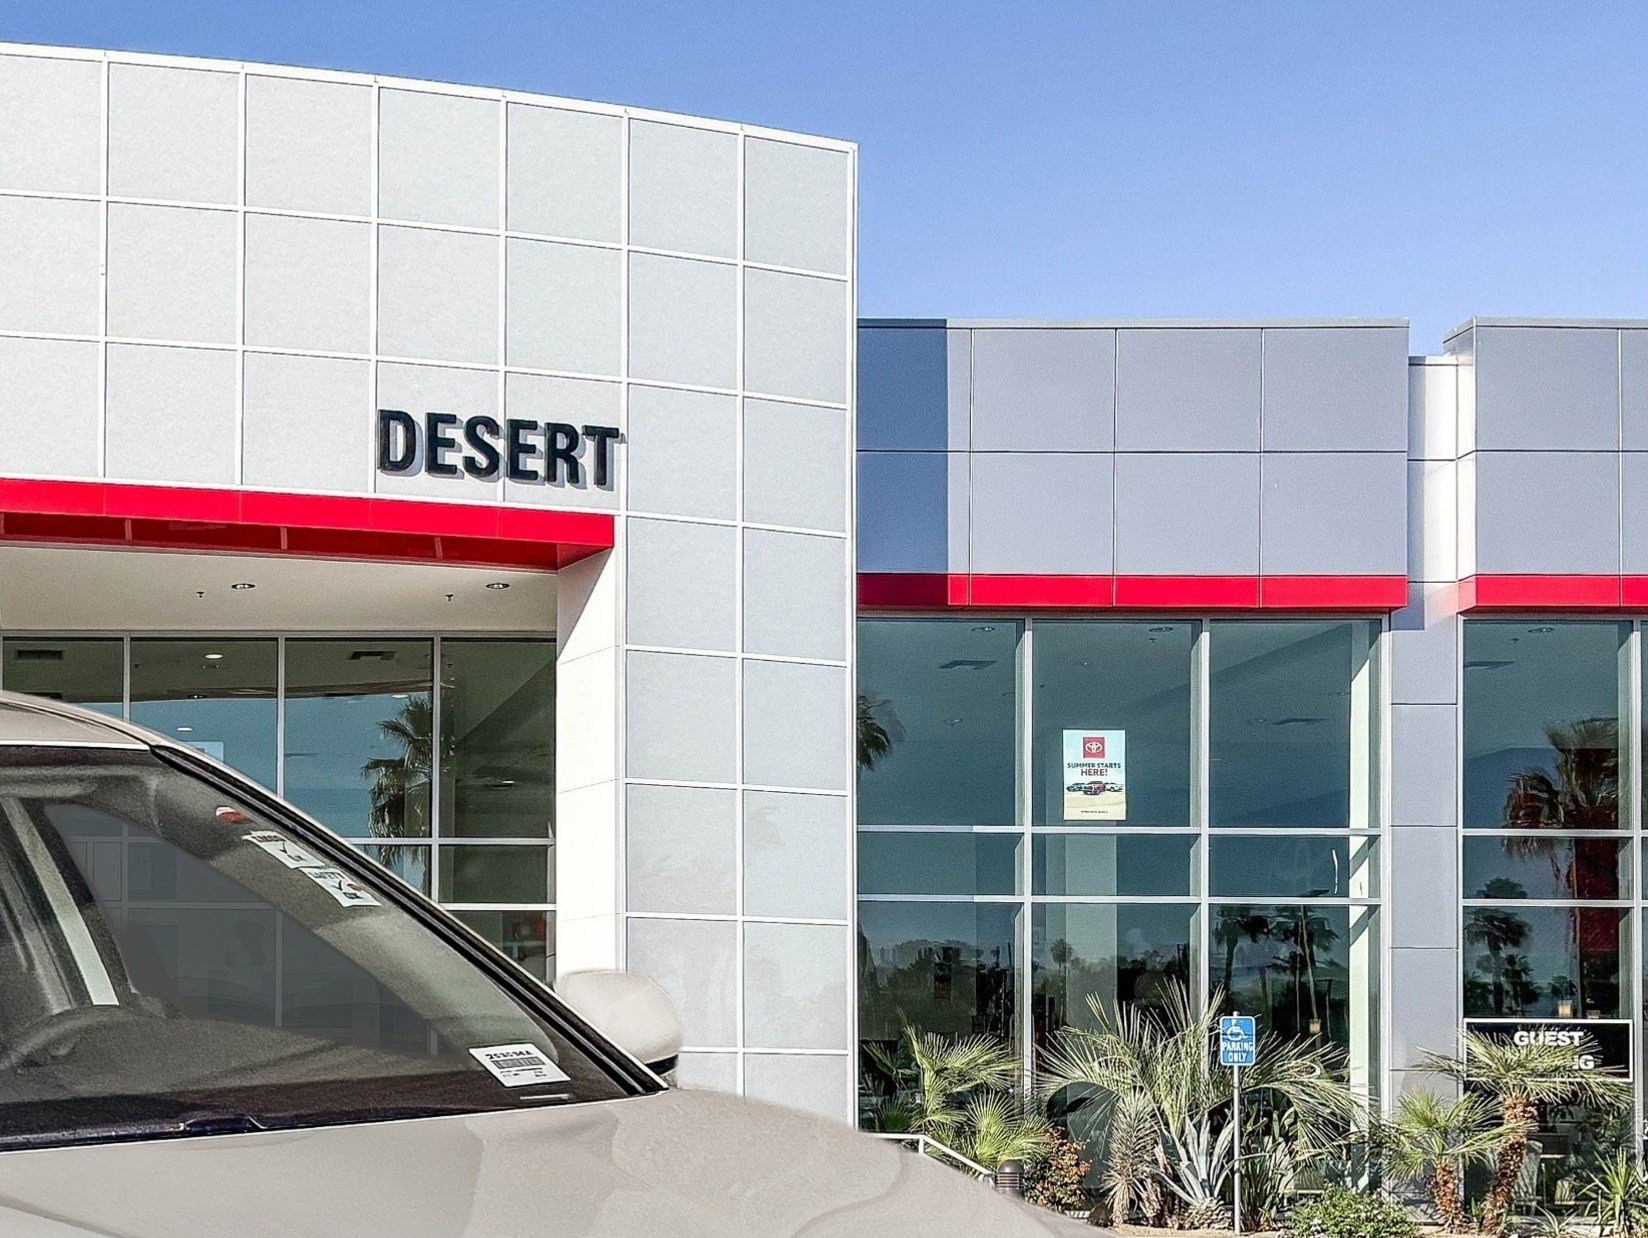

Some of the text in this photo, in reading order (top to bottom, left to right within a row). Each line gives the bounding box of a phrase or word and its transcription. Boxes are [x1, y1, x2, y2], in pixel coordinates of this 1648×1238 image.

[377, 409, 620, 486] DESERT
[1514, 1031, 1584, 1046] GUEST
[1222, 1041, 1253, 1051] PARKING
[1228, 1052, 1248, 1062] ONLY
